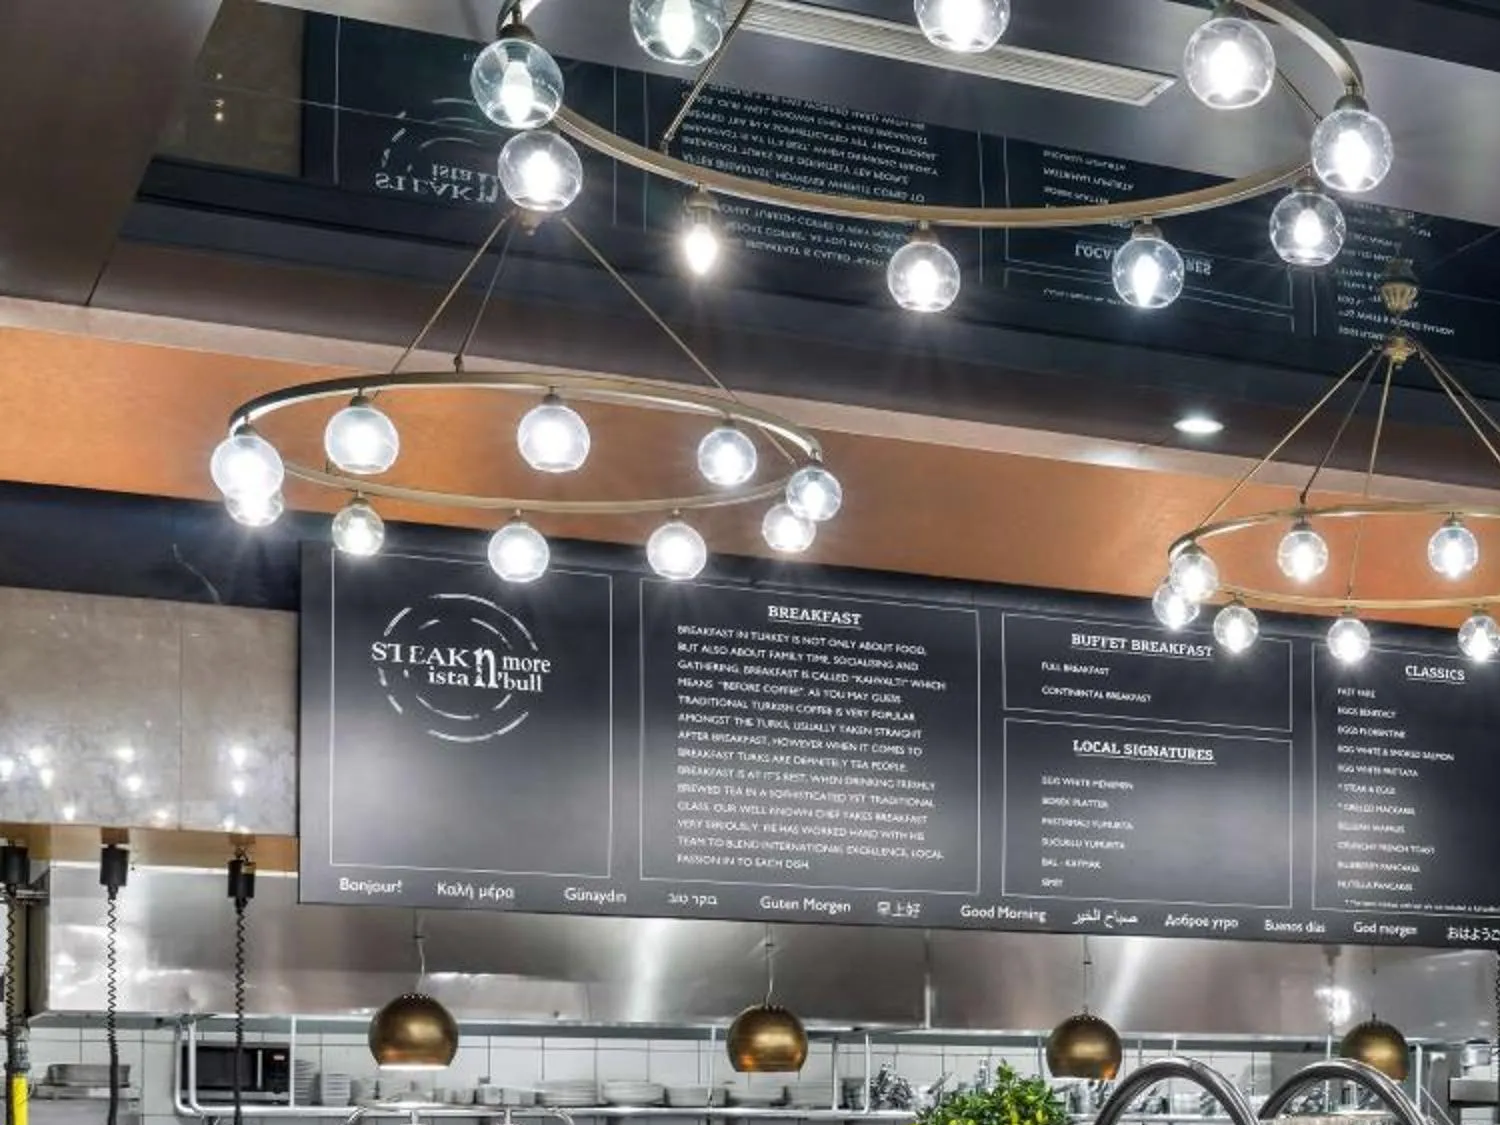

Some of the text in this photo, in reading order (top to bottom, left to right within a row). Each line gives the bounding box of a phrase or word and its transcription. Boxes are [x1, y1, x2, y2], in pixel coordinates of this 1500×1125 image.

[767, 605, 862, 626] BREAKFAST
[677, 624, 732, 637] BREAKFAST
[736, 629, 748, 639] IN
[751, 631, 789, 643] TURKEY
[802, 635, 826, 646] NOT
[827, 638, 854, 648] ONLY
[859, 640, 893, 652] ABOUT
[1071, 633, 1213, 658] BUFFET BREAKFAST
[502, 655, 551, 673] more
[677, 642, 698, 652] BUT
[701, 644, 728, 655] ALSO
[731, 646, 765, 657] ABOUT
[769, 650, 802, 661] FAMILY
[896, 661, 918, 671] AND
[427, 665, 470, 687] ista
[744, 665, 798, 678] BREAKFAST
[812, 671, 848, 682] CALLED
[911, 679, 945, 690] WHICH
[1405, 665, 1465, 681] CLASSICS
[677, 677, 713, 688] MEANS
[808, 688, 820, 697] AS
[823, 688, 843, 698] YOU
[846, 690, 867, 700] MAY
[679, 694, 747, 708] TRADITIONAL
[752, 700, 792, 711] TURKISH
[796, 703, 832, 714] COFFEE
[845, 707, 869, 717] VERY
[871, 710, 914, 721] POPULAR
[678, 712, 729, 724] AMONGST
[735, 716, 753, 726] THE
[793, 721, 836, 732] USUALLY
[839, 724, 870, 735] TAKEN
[874, 727, 921, 738] STRAIGHT
[677, 730, 707, 740] AFTER
[772, 737, 821, 748] HOWEVER
[826, 740, 856, 750] WHEN
[859, 742, 867, 751] IT
[871, 743, 904, 754] COMES
[908, 746, 922, 755] TO
[1073, 739, 1213, 761] LOCAL SIGNATURES
[677, 747, 732, 759] BREAKFAST
[739, 752, 769, 762] TURKS
[772, 754, 790, 764] ARE
[848, 759, 868, 768] TEA
[677, 765, 732, 777] BREAKFAST
[747, 770, 761, 779] AT
[810, 774, 840, 784] WHEN
[677, 783, 720, 794] BREWED
[723, 785, 742, 795] TEA
[745, 787, 756, 796] IN
[758, 788, 766, 797] A
[870, 795, 934, 807] TRADITIONAL
[713, 803, 735, 812] OUR
[738, 804, 766, 814] WELL
[677, 818, 700, 828] VERY
[802, 825, 846, 836] WORKED
[708, 837, 722, 847] TO
[726, 838, 758, 849] BLEND
[737, 857, 752, 866] TO
[339, 877, 403, 895] Bonjour!
[437, 881, 515, 901] Καλή μέρα
[760, 895, 851, 915] Guten Morgen
[960, 904, 1047, 924] Good Morning
[1164, 913, 1239, 931] Доброе утро
[1264, 919, 1302, 933] Buenos
[1353, 921, 1419, 939] God morgen
